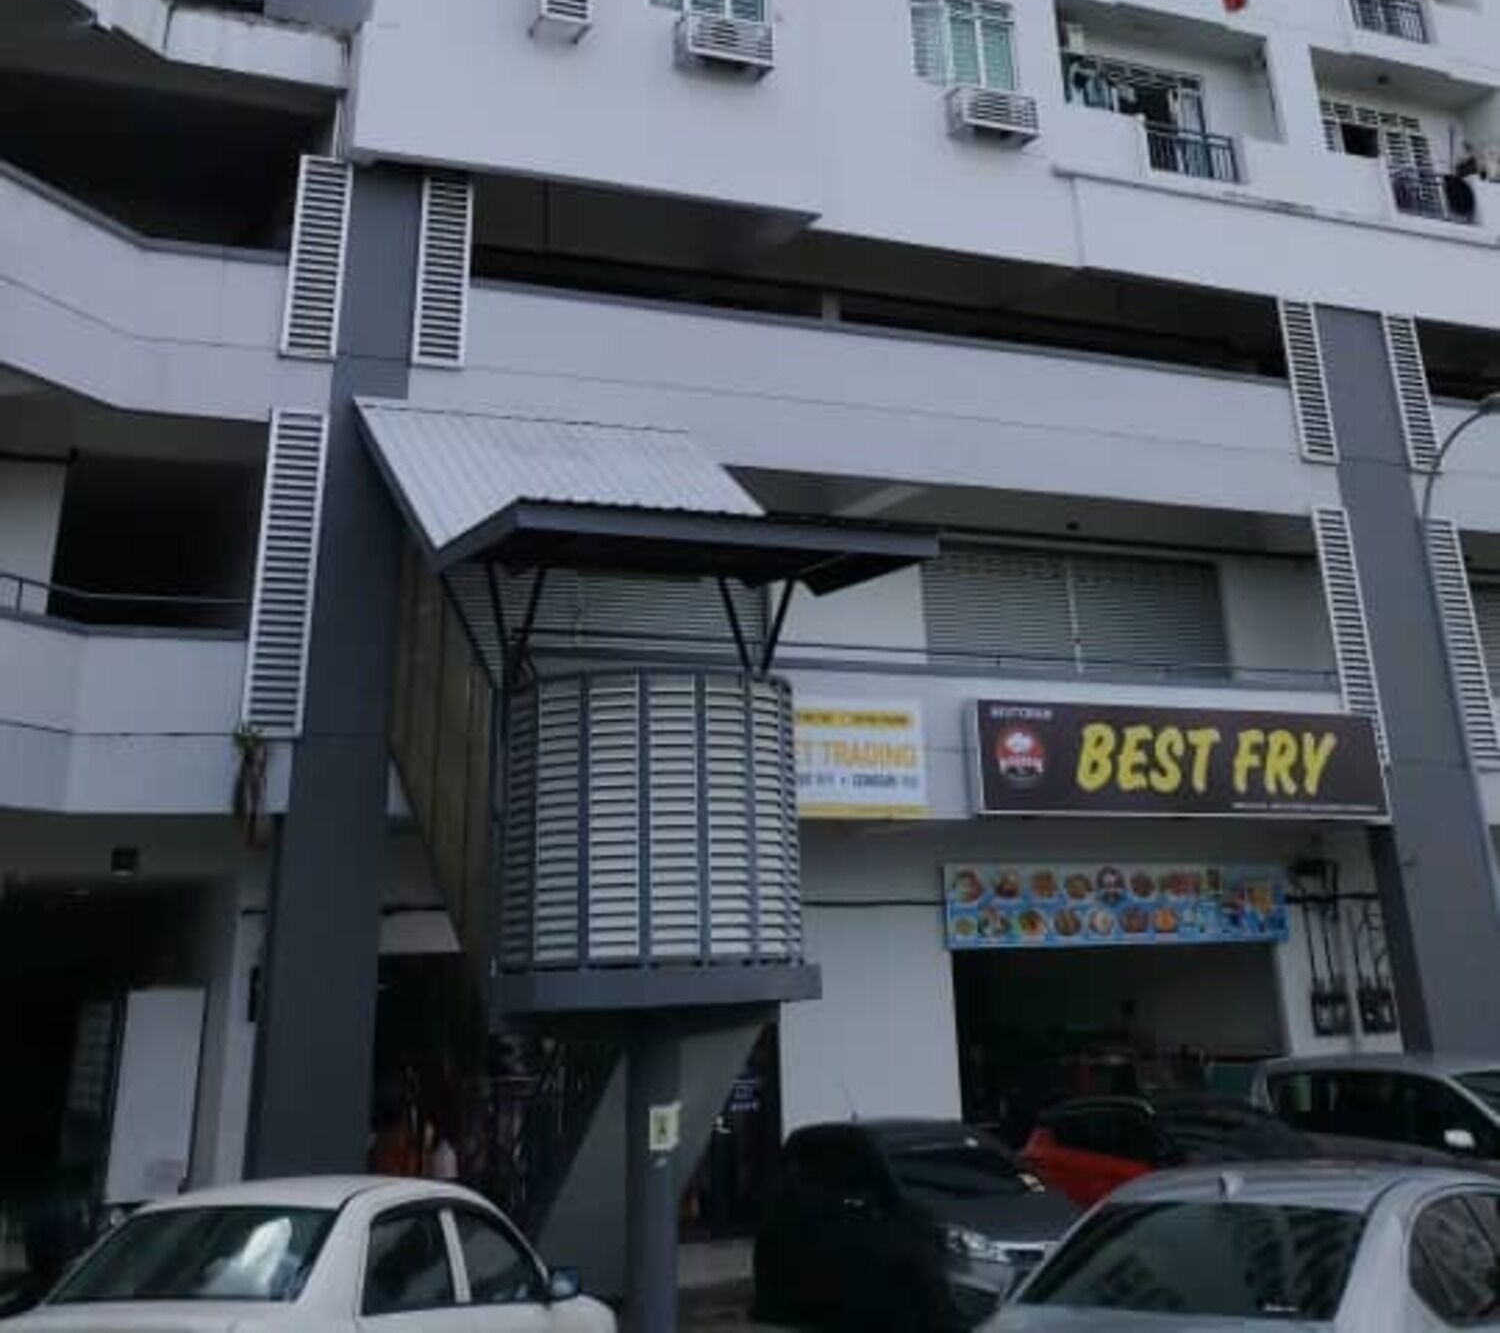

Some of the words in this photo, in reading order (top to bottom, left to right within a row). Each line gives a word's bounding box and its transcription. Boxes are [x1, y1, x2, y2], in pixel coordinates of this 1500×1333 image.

[820, 739, 918, 768] TRADING
[1076, 722, 1221, 792] BEST
[1232, 728, 1338, 796] FRY
